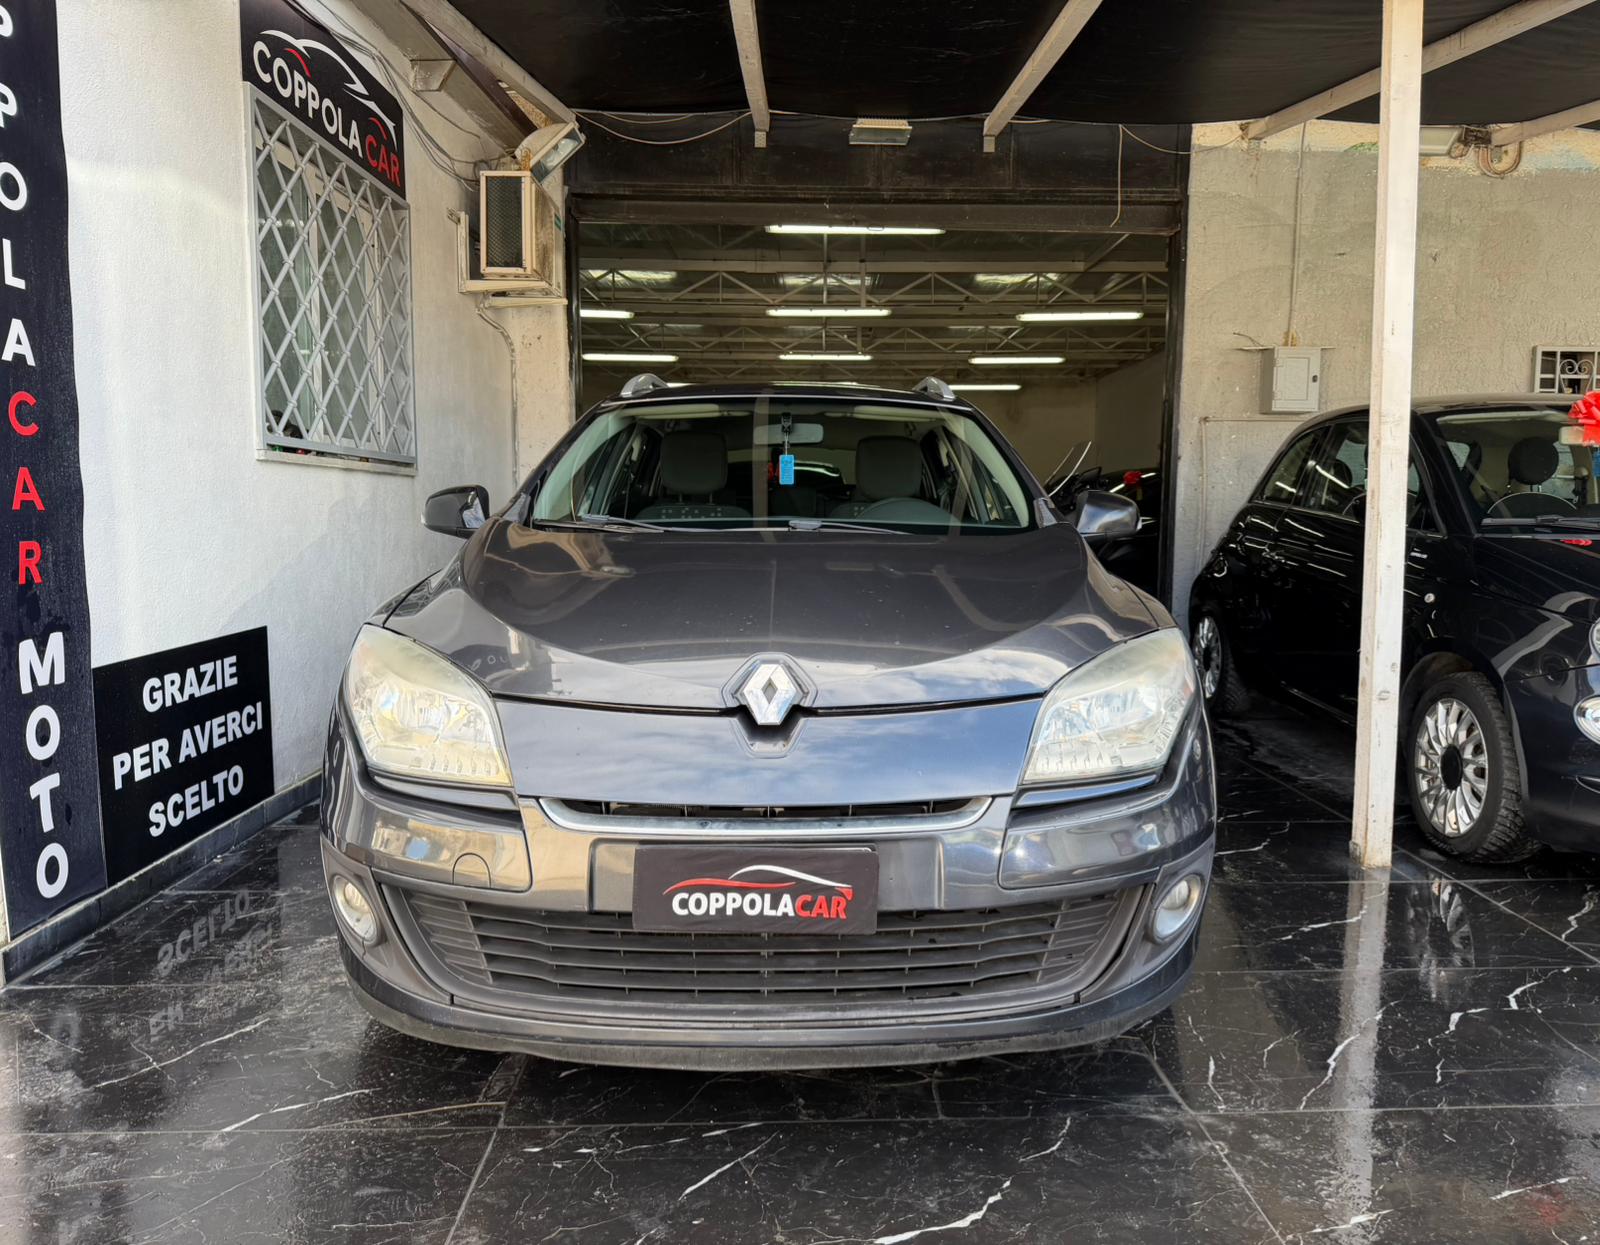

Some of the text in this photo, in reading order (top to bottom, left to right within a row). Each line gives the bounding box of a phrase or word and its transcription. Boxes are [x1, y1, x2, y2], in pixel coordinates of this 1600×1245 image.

[142, 655, 239, 713] GRAZIE
[18, 631, 69, 899] MOTO
[112, 701, 264, 791] PER AVERCI
[148, 764, 245, 838] SCELTO
